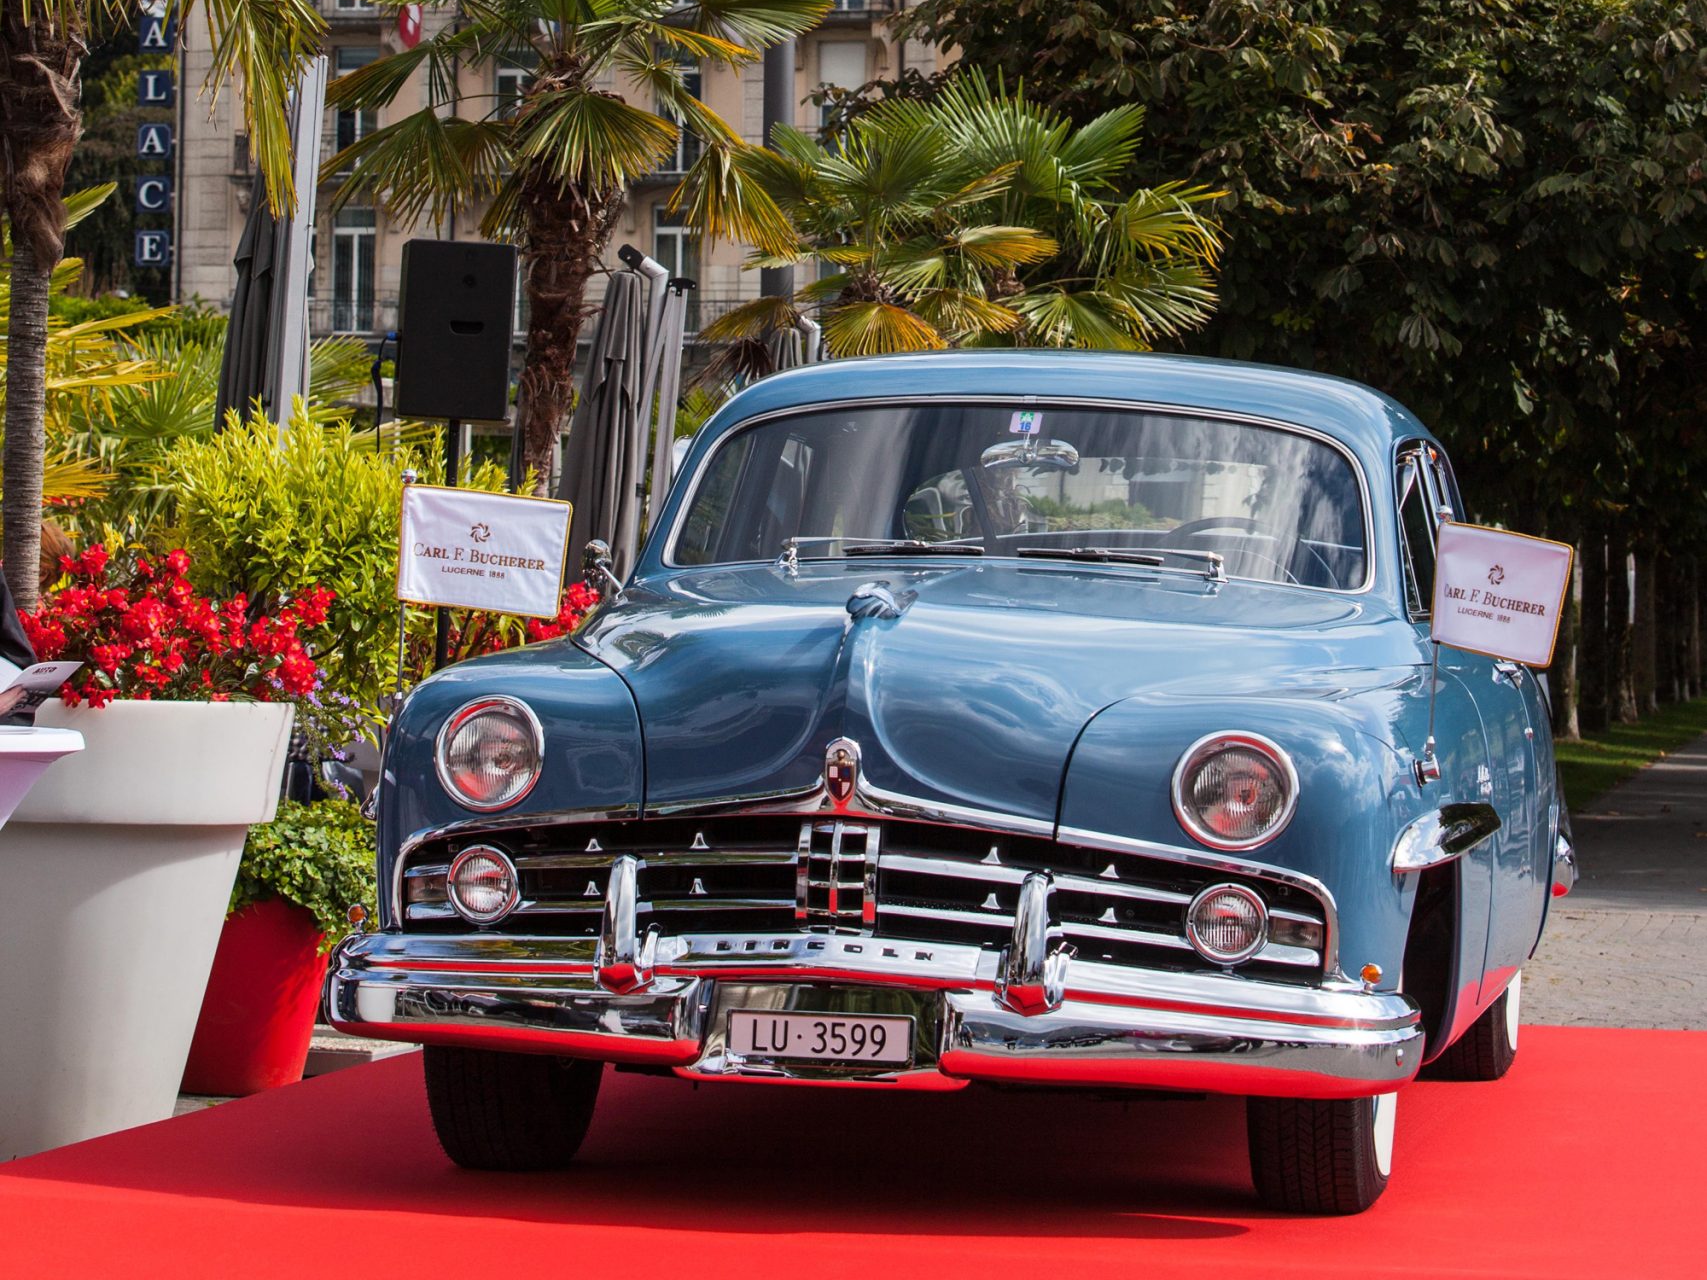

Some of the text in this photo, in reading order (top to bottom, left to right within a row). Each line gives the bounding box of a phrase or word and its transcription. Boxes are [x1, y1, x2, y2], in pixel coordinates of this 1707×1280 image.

[1020, 421, 1032, 431] 16
[413, 542, 546, 571] CARL F. BUCHERER
[441, 565, 506, 580] LUCERNE 1888
[1443, 583, 1546, 617] CARL F. BUCHERER
[1457, 606, 1494, 620] LUCERNE
[716, 939, 934, 962] LINCOLN
